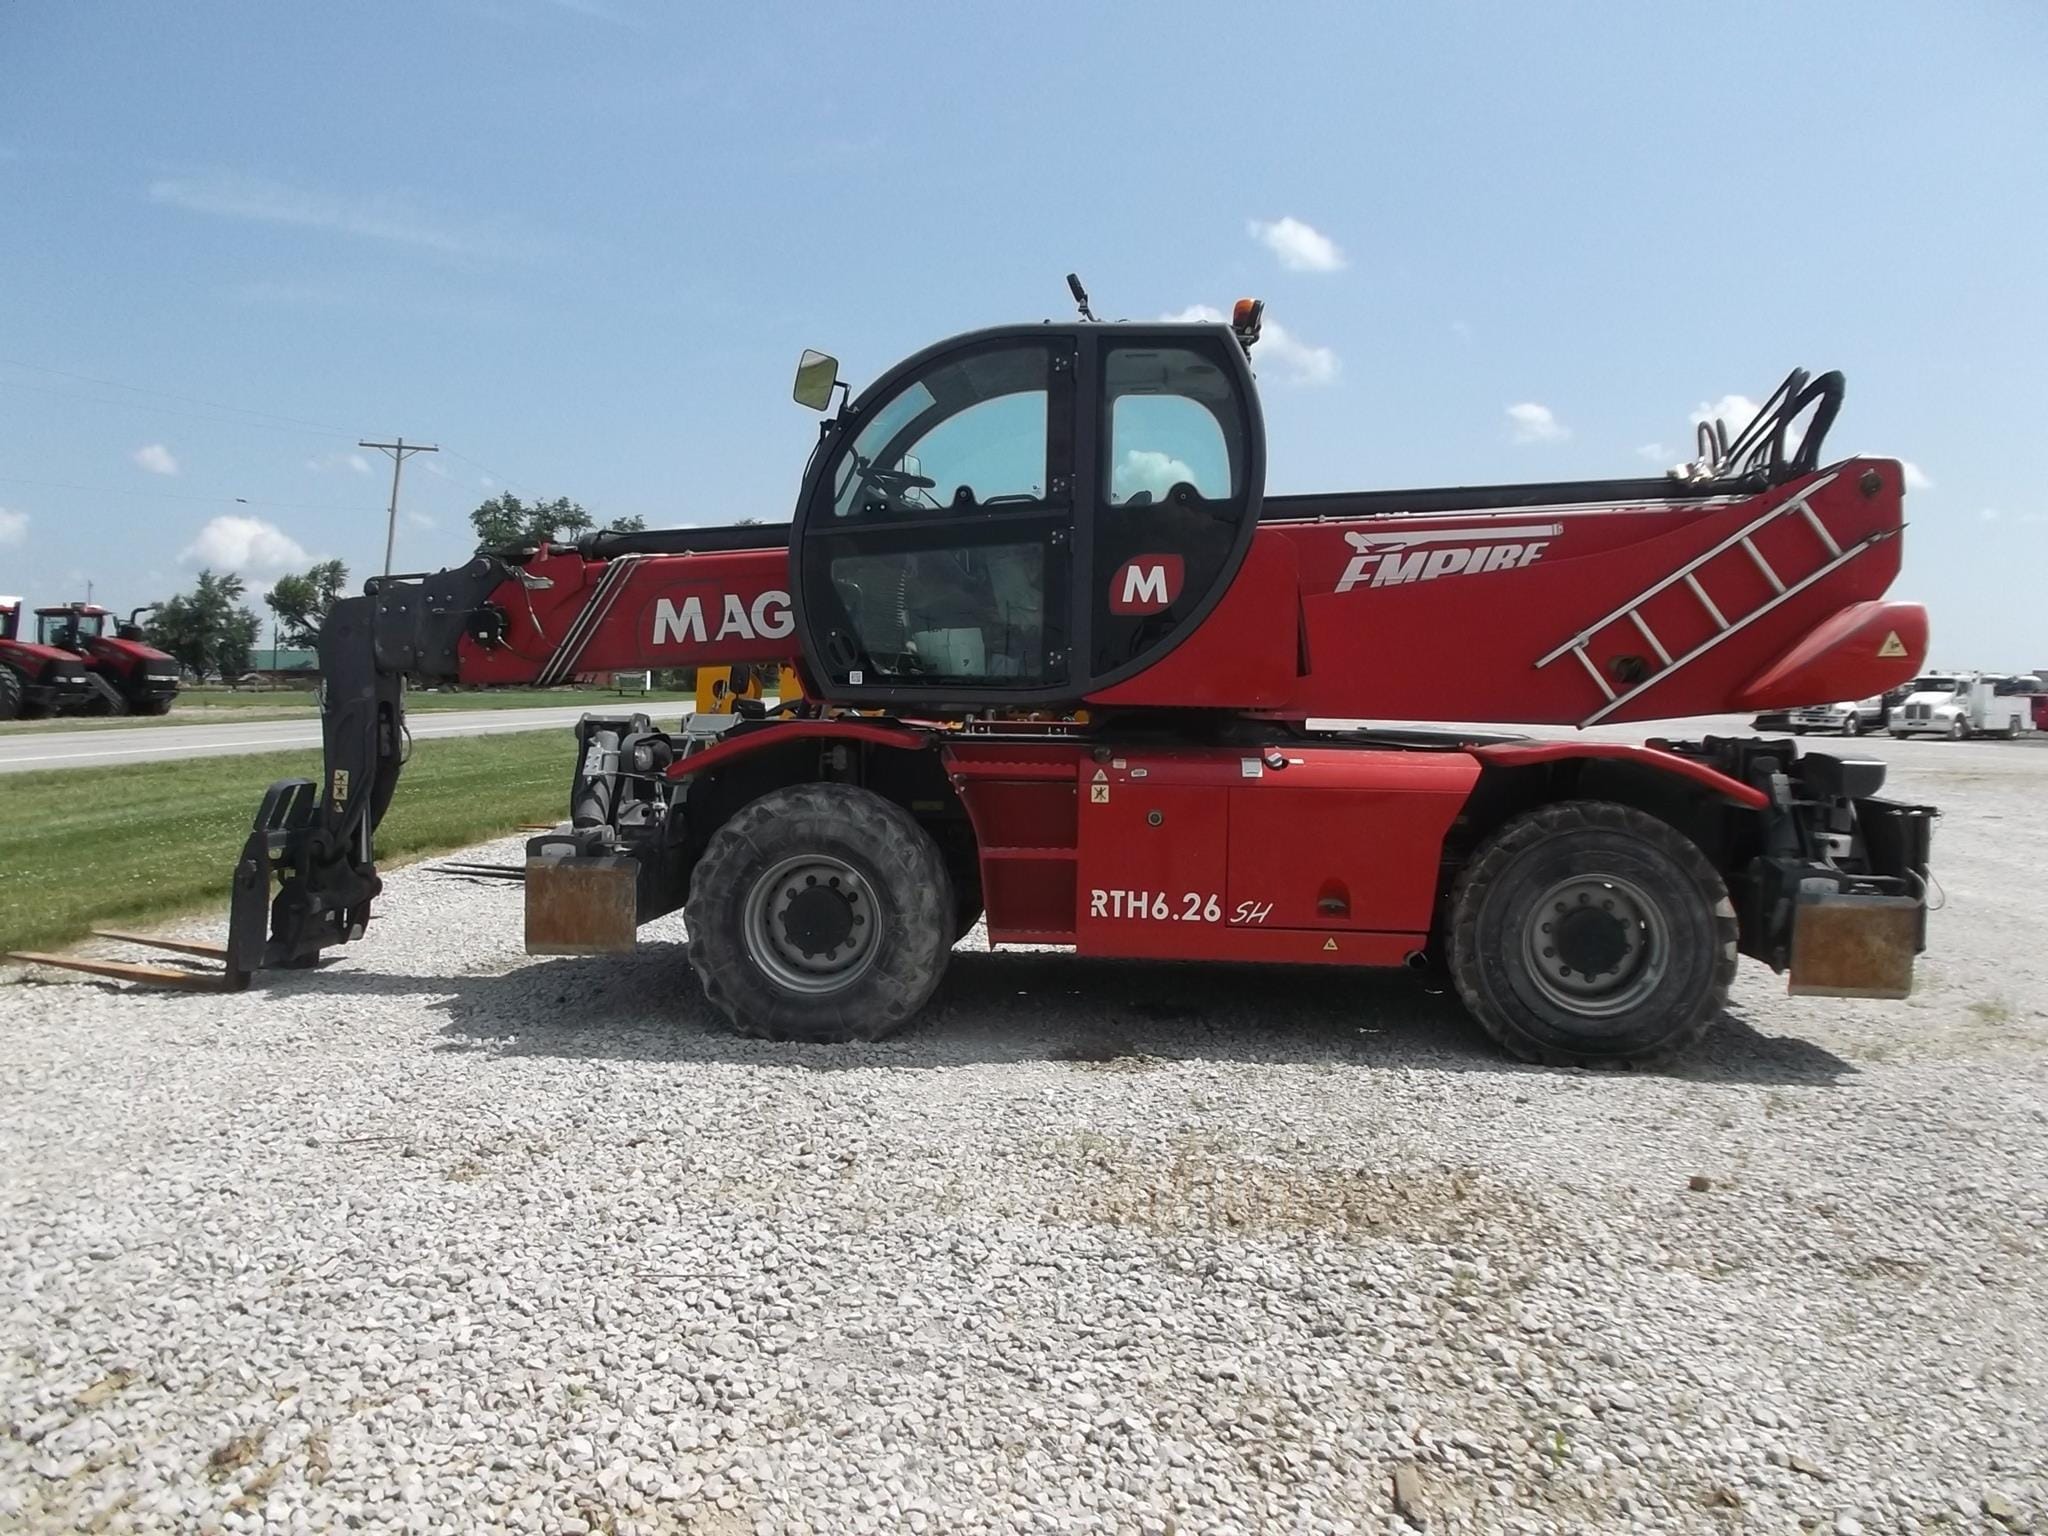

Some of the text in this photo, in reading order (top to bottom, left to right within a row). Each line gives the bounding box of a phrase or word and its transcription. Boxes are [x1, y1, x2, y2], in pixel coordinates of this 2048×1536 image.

[1122, 565, 1168, 603] M
[1091, 889, 1273, 924] RTH6.26 SH
